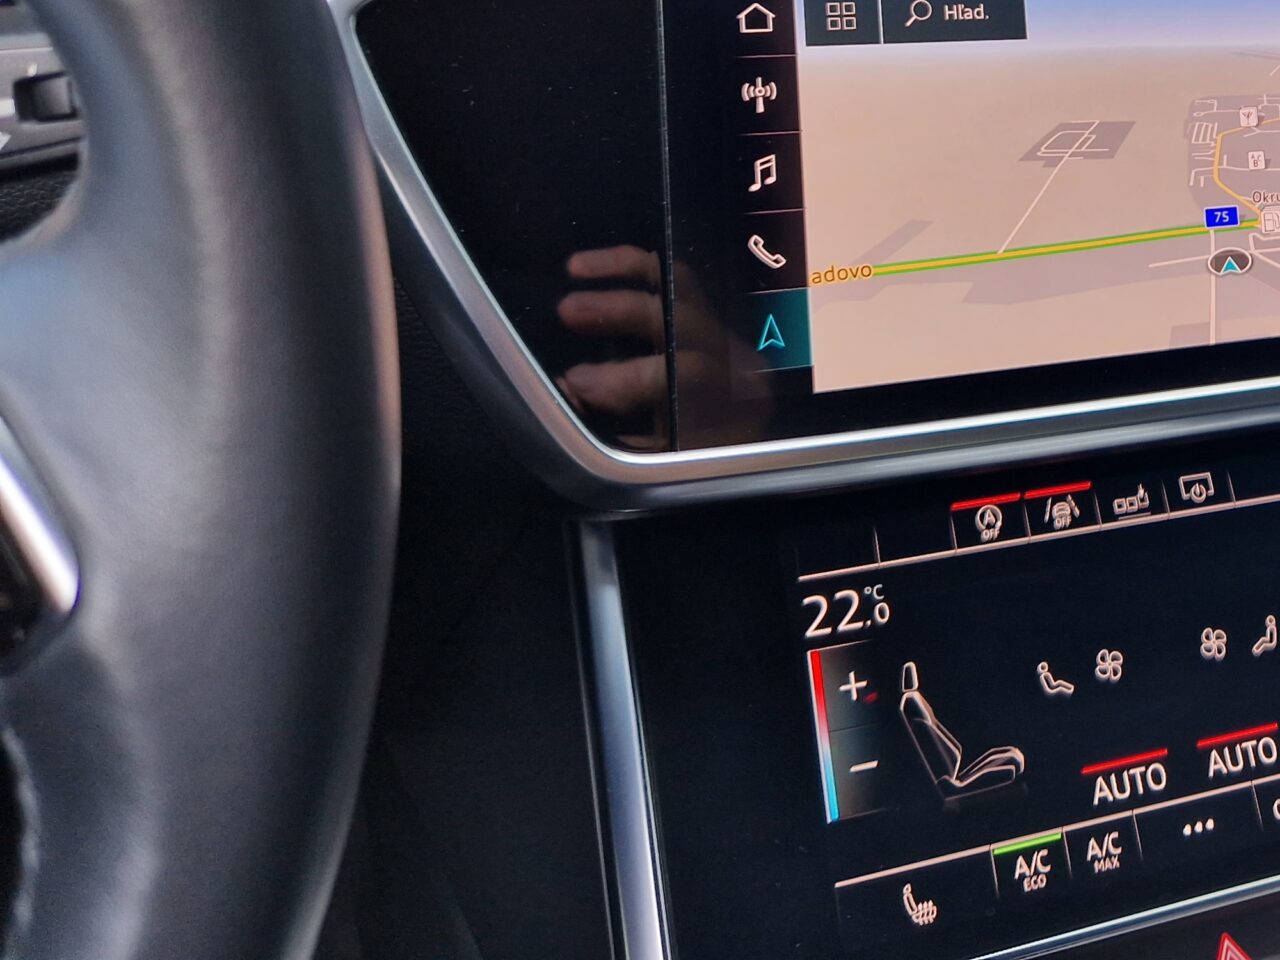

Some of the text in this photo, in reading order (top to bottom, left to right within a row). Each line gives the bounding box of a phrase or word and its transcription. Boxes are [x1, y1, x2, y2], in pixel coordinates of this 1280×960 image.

[1213, 211, 1230, 223] 75
[811, 265, 872, 284] adovo
[1053, 516, 1072, 531] OFF
[980, 527, 1001, 543] OFF
[1207, 737, 1279, 779] AUTO
[1092, 762, 1168, 806] AUTO
[1086, 831, 1122, 861] A/C
[1014, 848, 1052, 880] A/C
[1093, 855, 1120, 874] MAX
[1023, 873, 1047, 893] ECO
